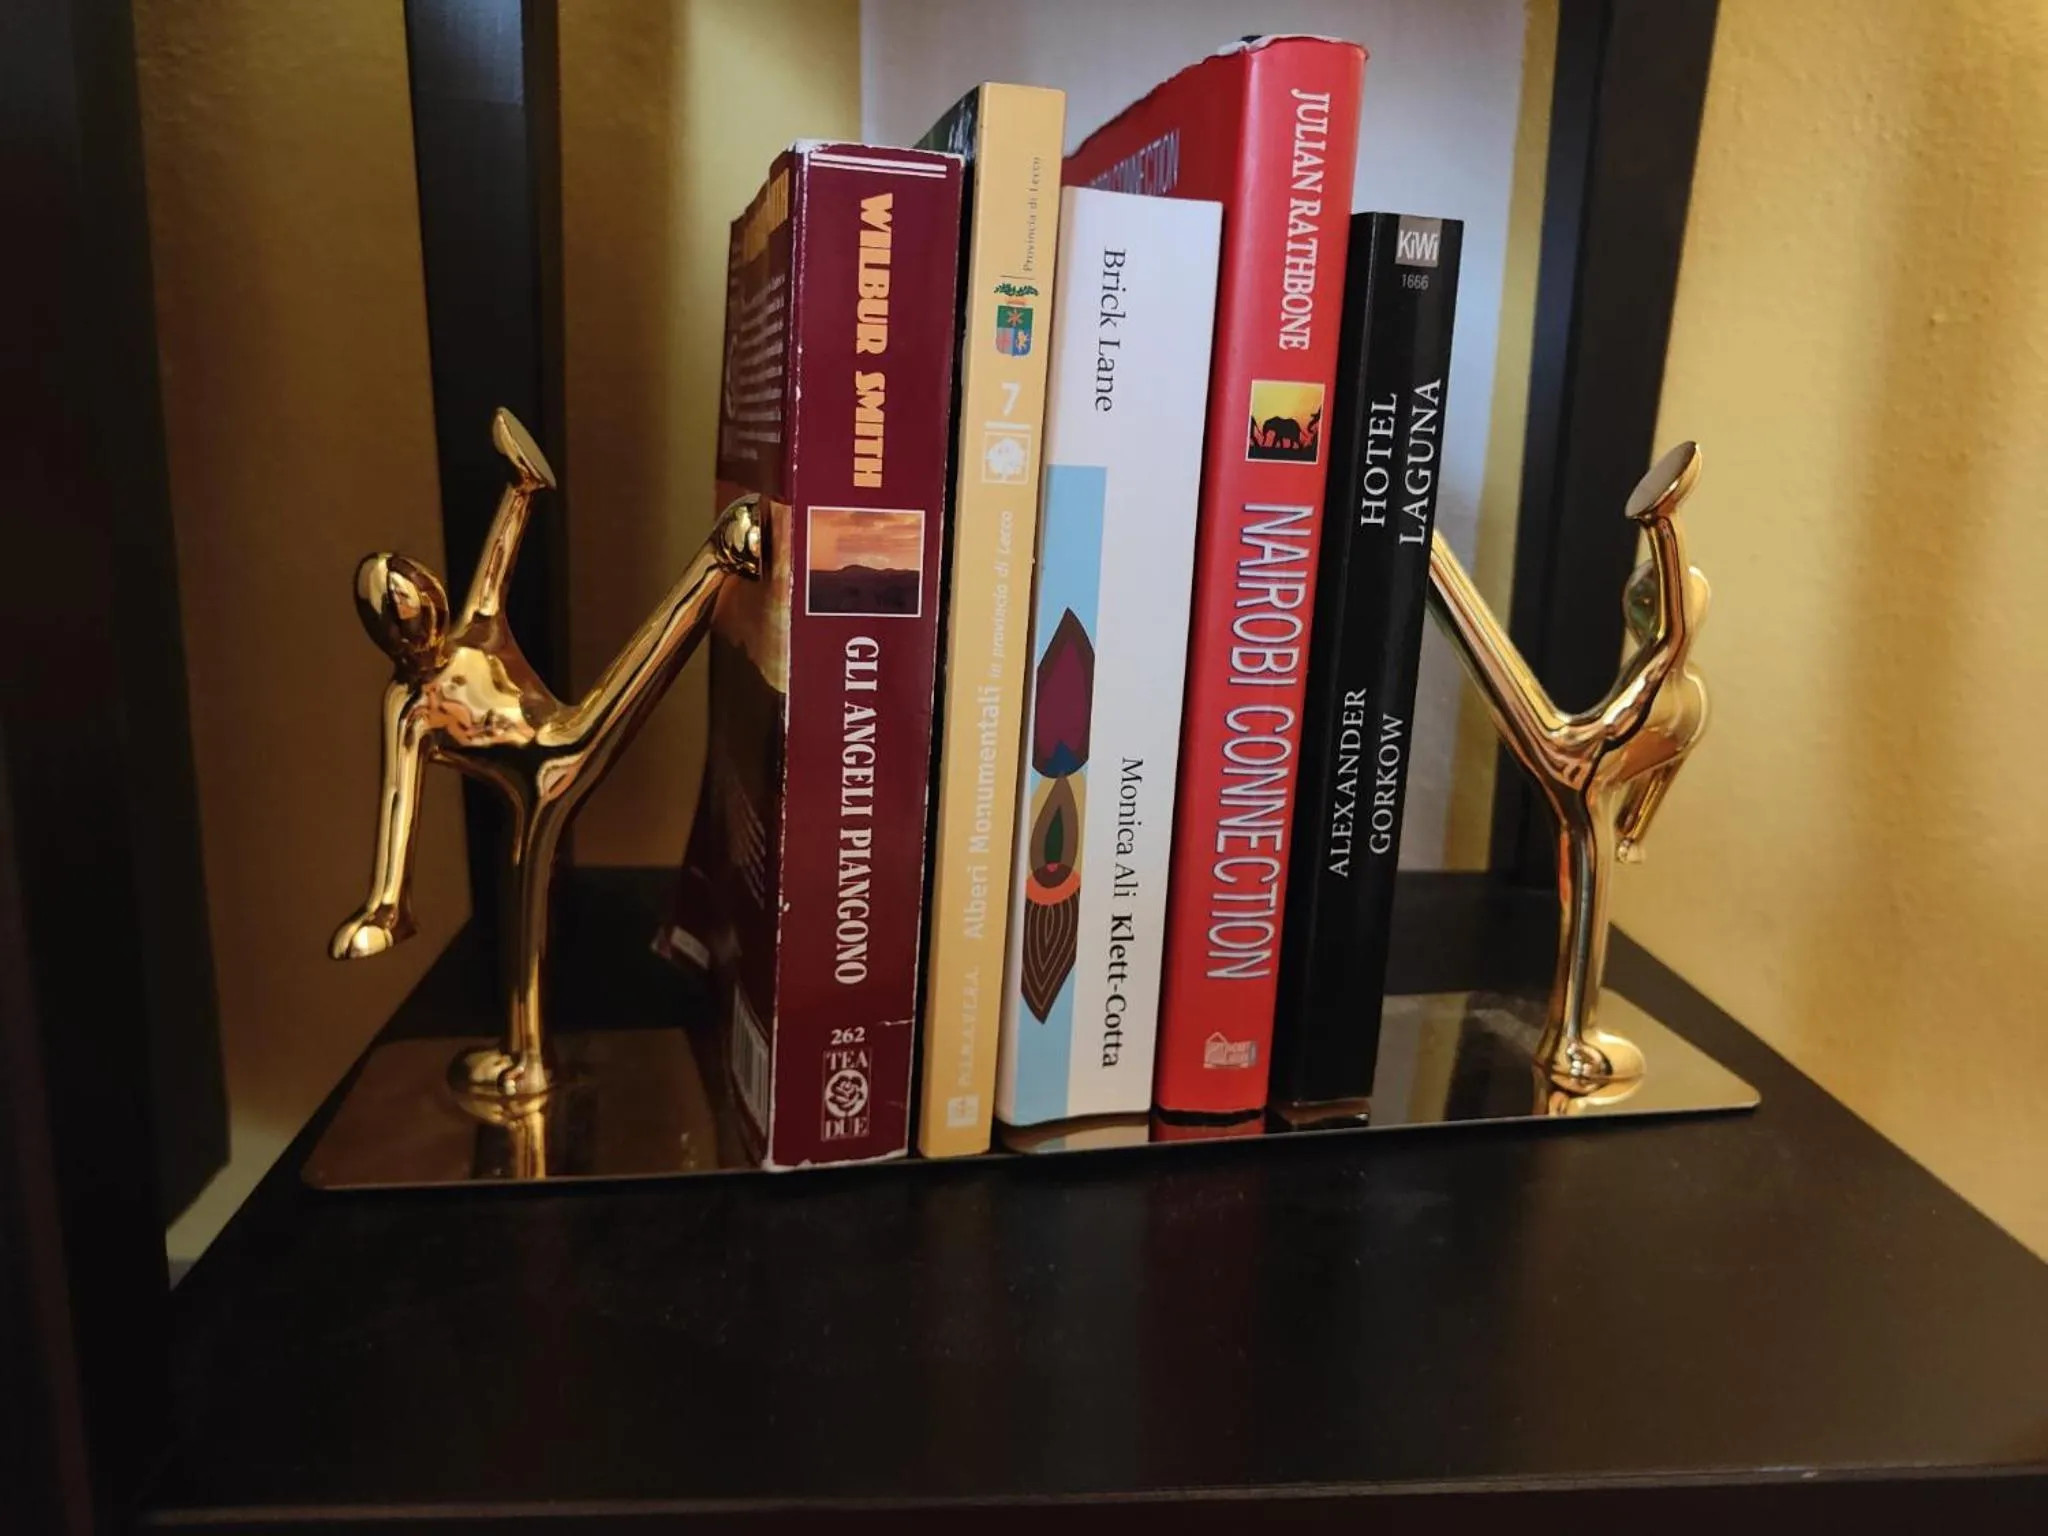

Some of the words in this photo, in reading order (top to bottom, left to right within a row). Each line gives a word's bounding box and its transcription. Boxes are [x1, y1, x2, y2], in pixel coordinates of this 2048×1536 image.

[1291, 89, 1330, 199] JULIAN
[855, 193, 893, 354] WILBUR
[1098, 247, 1126, 328] Brick
[1278, 200, 1320, 352] RATHBONE
[1401, 273, 1430, 290] 1666
[853, 370, 885, 488] SMITH
[999, 380, 1022, 416] 7
[1094, 336, 1122, 412] Lane
[1361, 392, 1398, 529] HOTEL
[1399, 377, 1442, 546] LAGUNA
[1228, 502, 1315, 686] NAIROBI
[843, 635, 880, 691] GLI
[839, 701, 877, 816] ANGELI
[968, 685, 1001, 854] Monumentali
[1115, 755, 1144, 856] Monica
[1328, 688, 1368, 878] ALEXANDER
[1369, 713, 1405, 855] GORKOW
[1112, 862, 1139, 898] Ali
[1203, 703, 1295, 980] CONNECTION
[834, 827, 873, 985] PIANGONO
[962, 864, 988, 940] Alberi
[830, 1026, 866, 1046] 262
[1101, 912, 1136, 1069] Klett-Cotta
[826, 1049, 868, 1071] TEA
[825, 1117, 869, 1140] DUE
